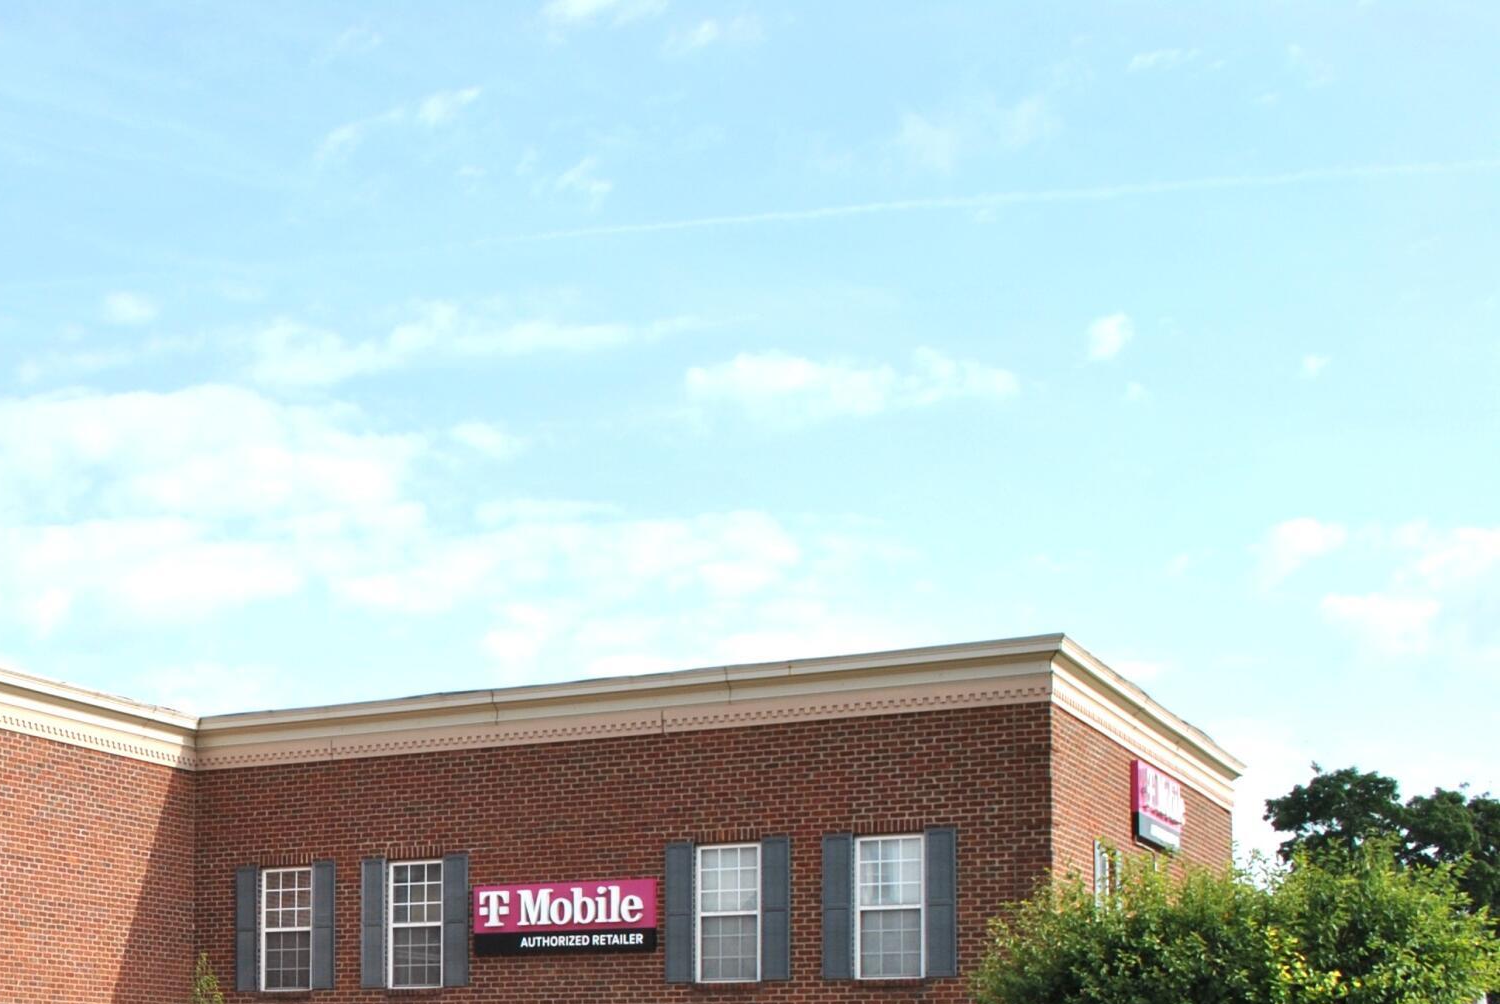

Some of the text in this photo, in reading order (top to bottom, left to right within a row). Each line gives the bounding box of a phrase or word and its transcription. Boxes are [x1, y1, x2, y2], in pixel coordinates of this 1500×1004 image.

[516, 885, 644, 926] Mobile
[520, 933, 644, 948] AUTHORIZED RETAILER
